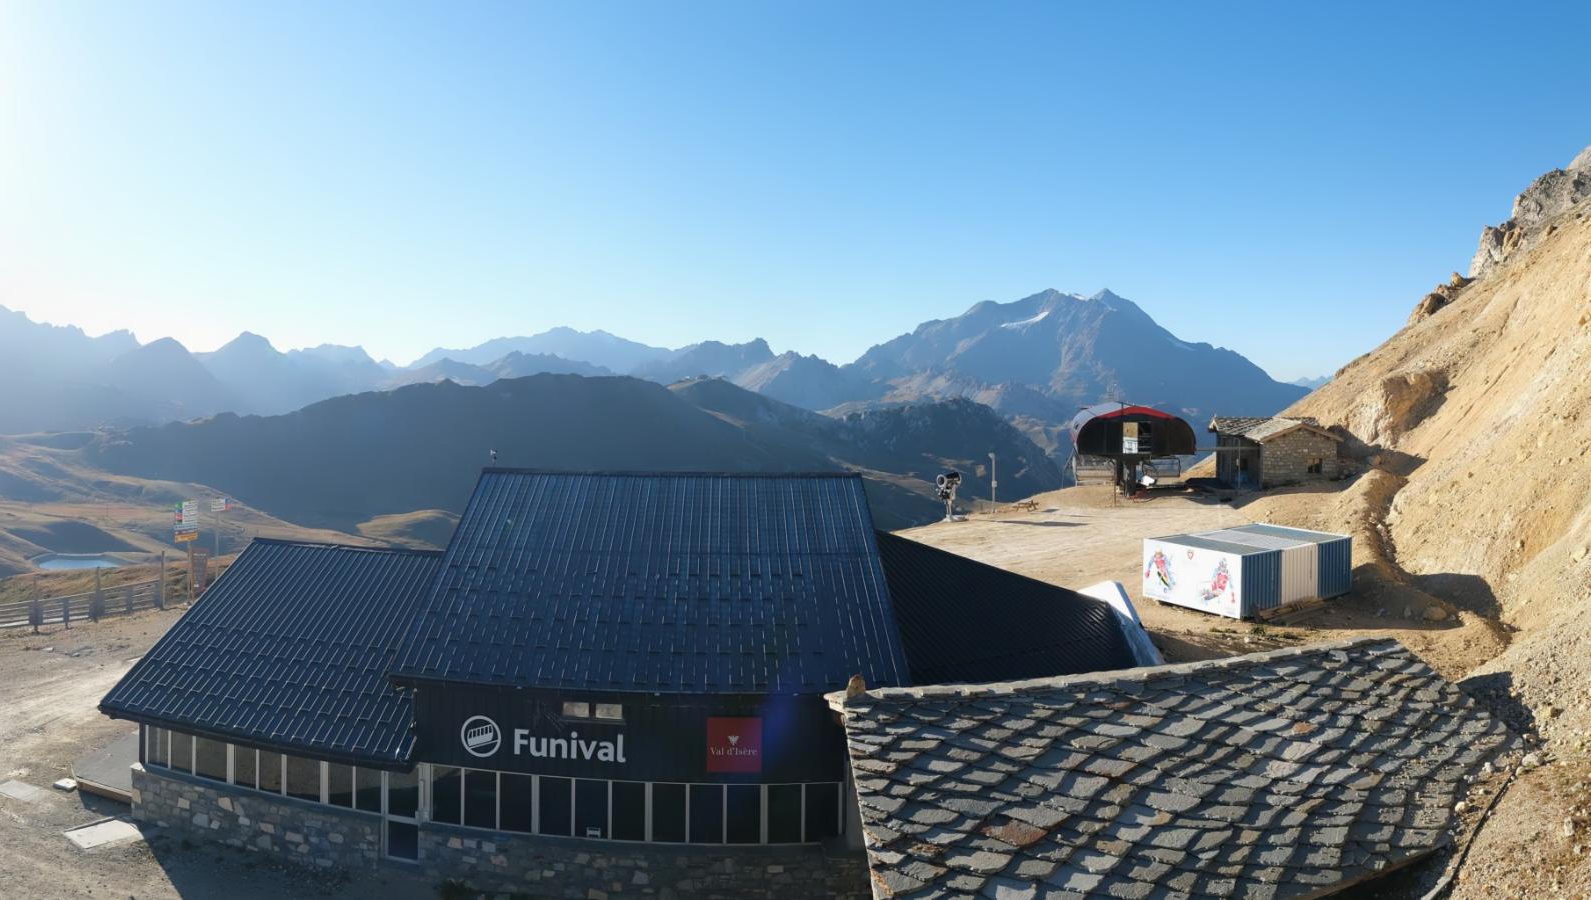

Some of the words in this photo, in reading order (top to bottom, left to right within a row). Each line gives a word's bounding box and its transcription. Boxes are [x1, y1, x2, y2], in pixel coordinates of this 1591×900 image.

[514, 728, 626, 763] Funival
[710, 747, 724, 756] Val
[726, 746, 758, 756] d'Isère
